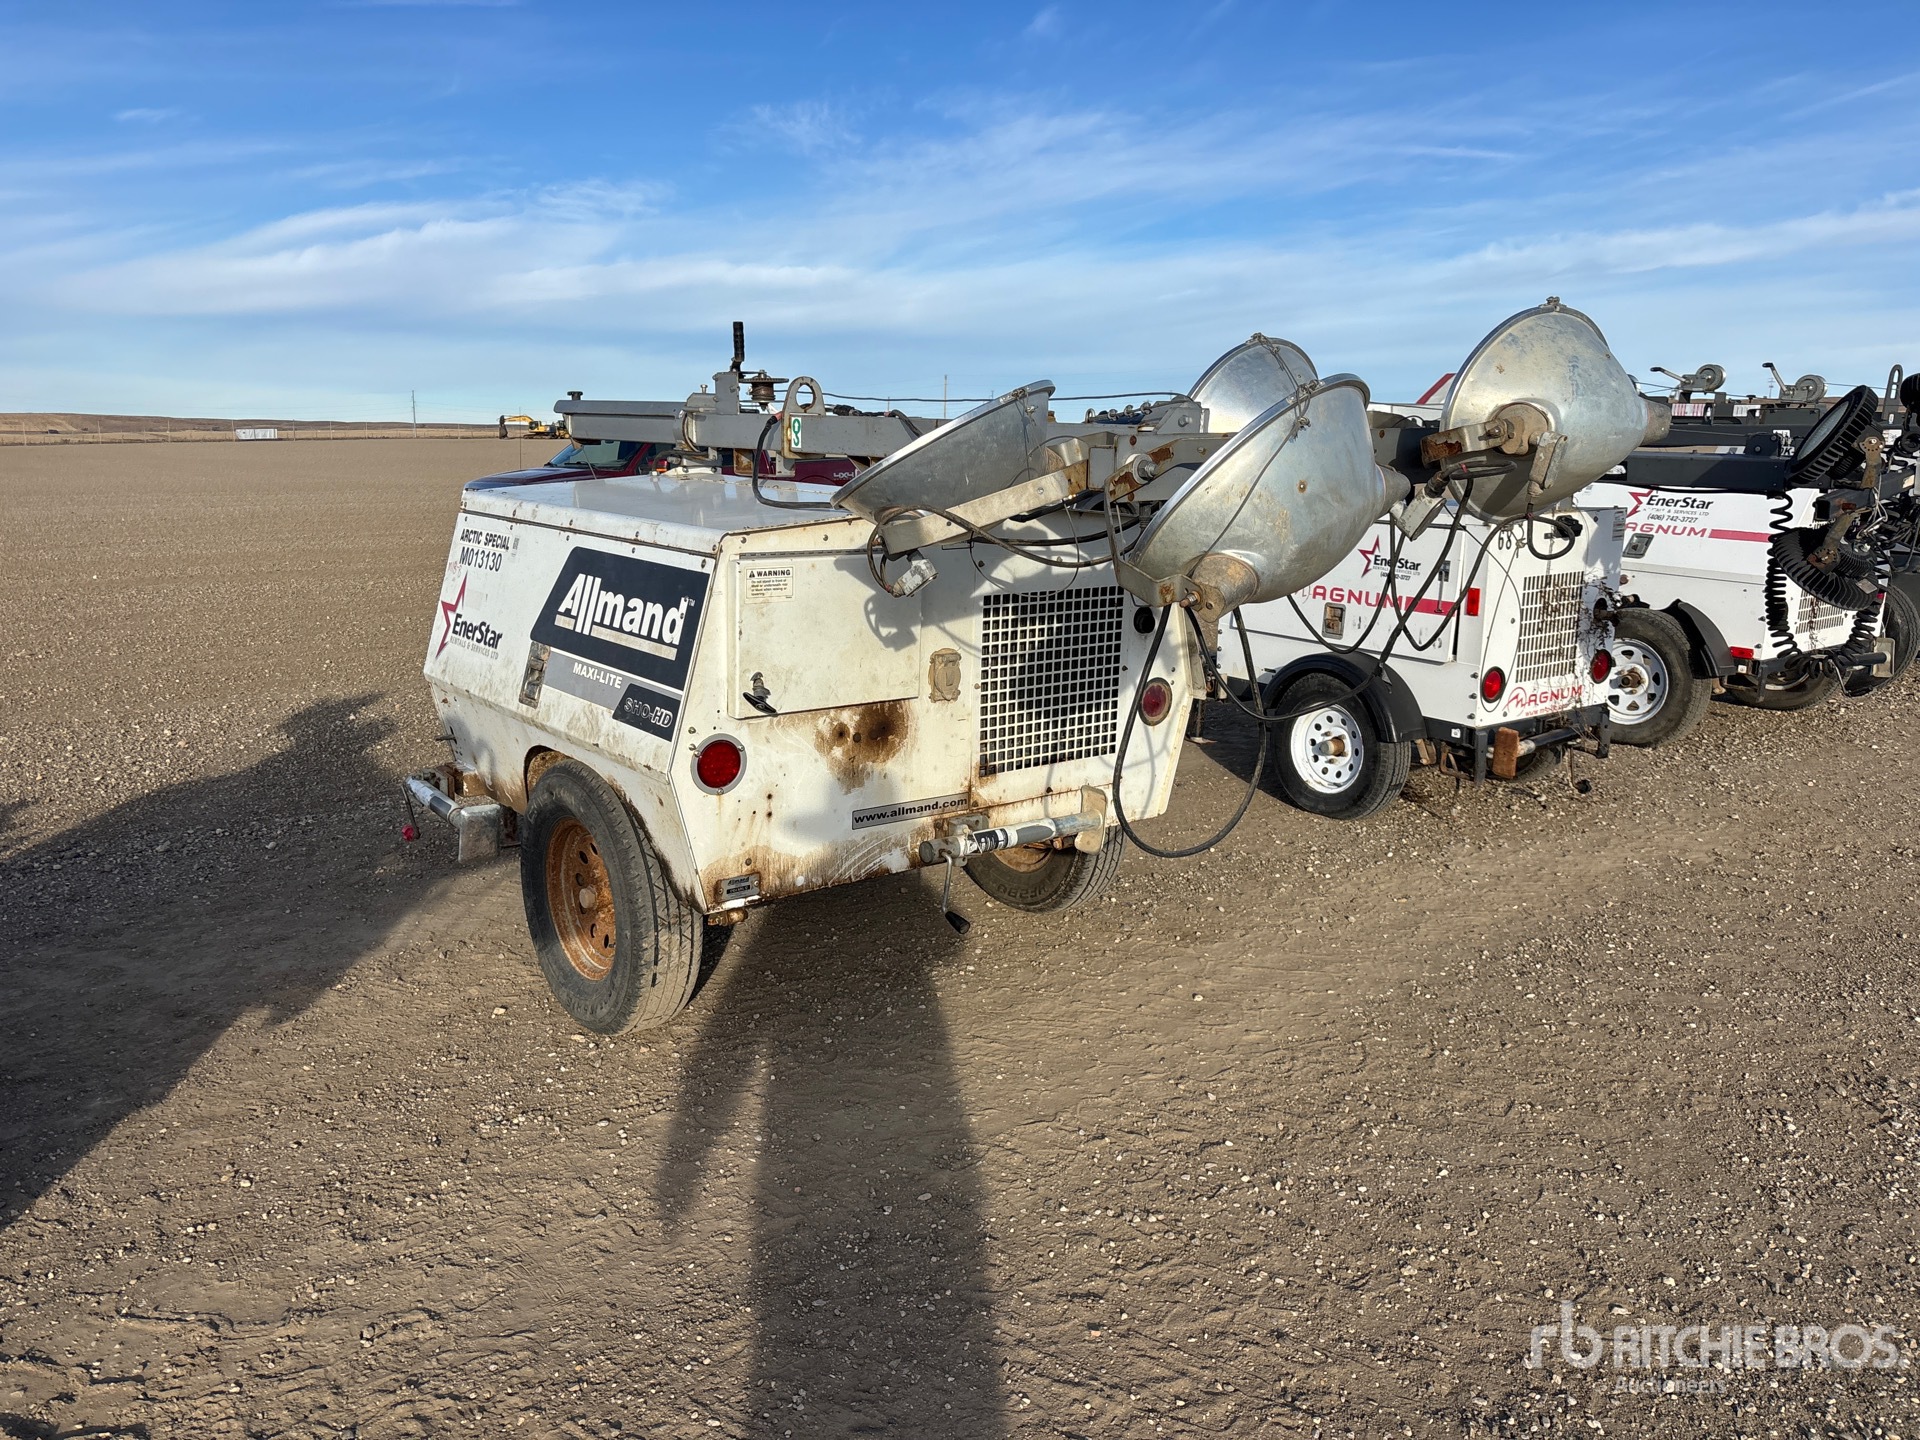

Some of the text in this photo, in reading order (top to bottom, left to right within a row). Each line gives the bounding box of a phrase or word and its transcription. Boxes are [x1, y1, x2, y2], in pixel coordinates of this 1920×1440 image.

[1646, 495, 1714, 510] EnerStar
[460, 529, 482, 546] ARCTIC
[484, 532, 510, 551] SPECIAL
[1625, 522, 1707, 538] AGNUM
[460, 546, 502, 572] M013130
[1373, 554, 1421, 572] EneStar
[757, 569, 791, 578] WARNING
[558, 573, 688, 646] Allmand
[452, 613, 503, 650] EnerStar
[573, 662, 623, 689] MAXI-LITE
[854, 798, 968, 824] www.allmand.com
